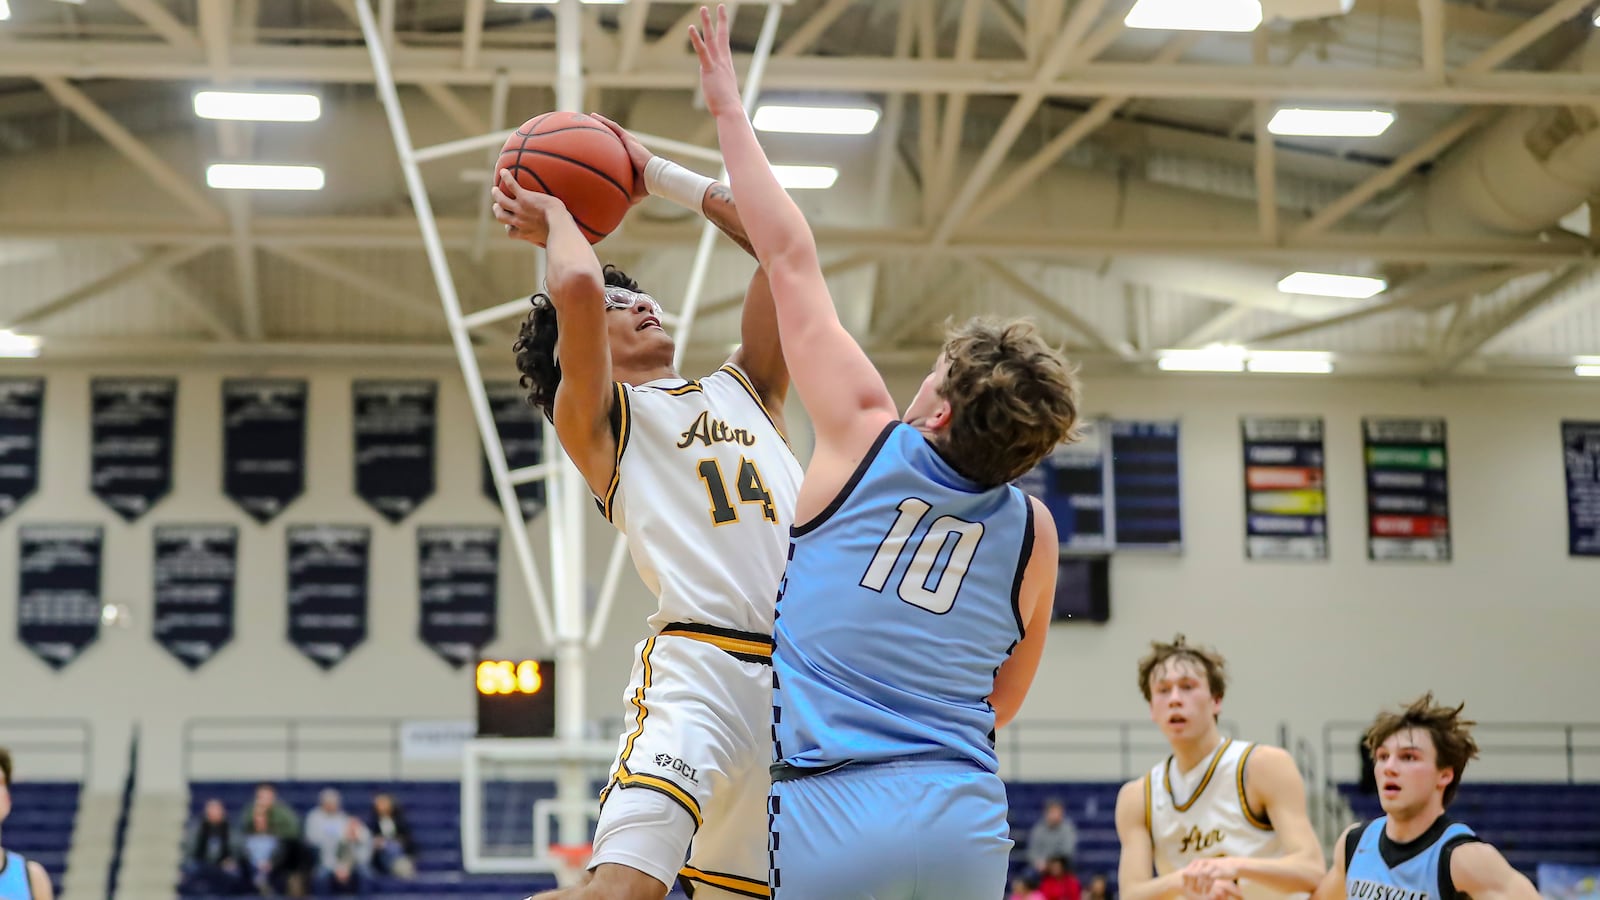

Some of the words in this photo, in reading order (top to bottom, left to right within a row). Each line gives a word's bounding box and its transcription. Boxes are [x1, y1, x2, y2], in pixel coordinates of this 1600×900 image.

[696, 454, 779, 527] 14
[858, 496, 985, 615] 10
[672, 758, 699, 783] GCL
